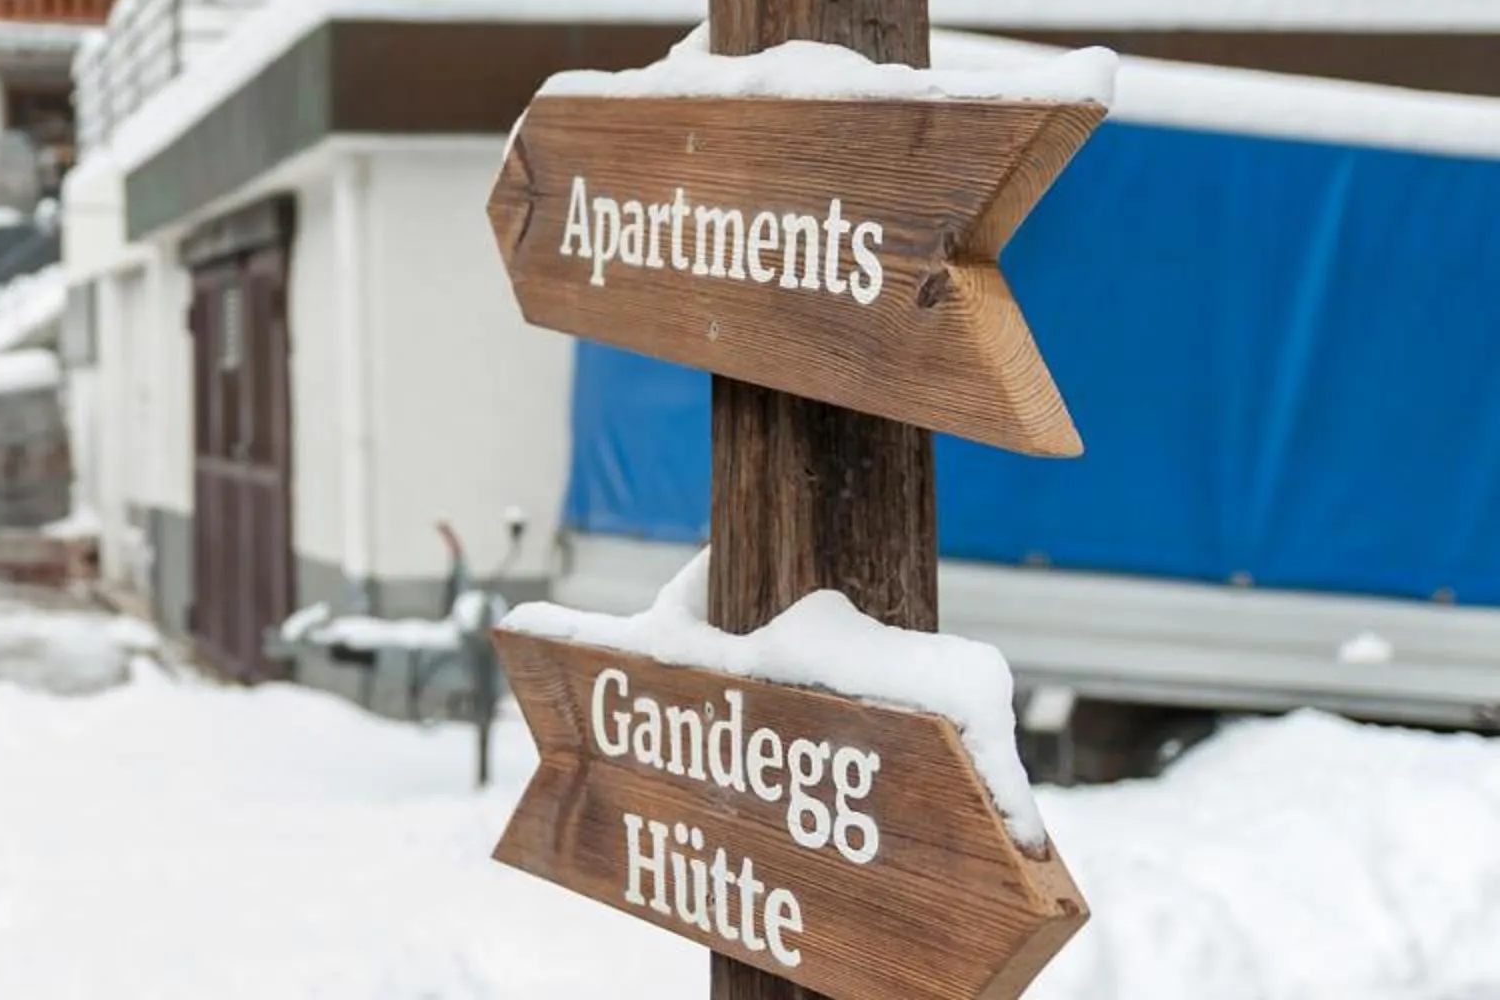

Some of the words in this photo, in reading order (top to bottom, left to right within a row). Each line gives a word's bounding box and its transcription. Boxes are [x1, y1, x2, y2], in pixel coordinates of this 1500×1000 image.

[559, 175, 884, 306] Apartments
[591, 667, 881, 865] Gandegg
[623, 812, 805, 968] Hütte
